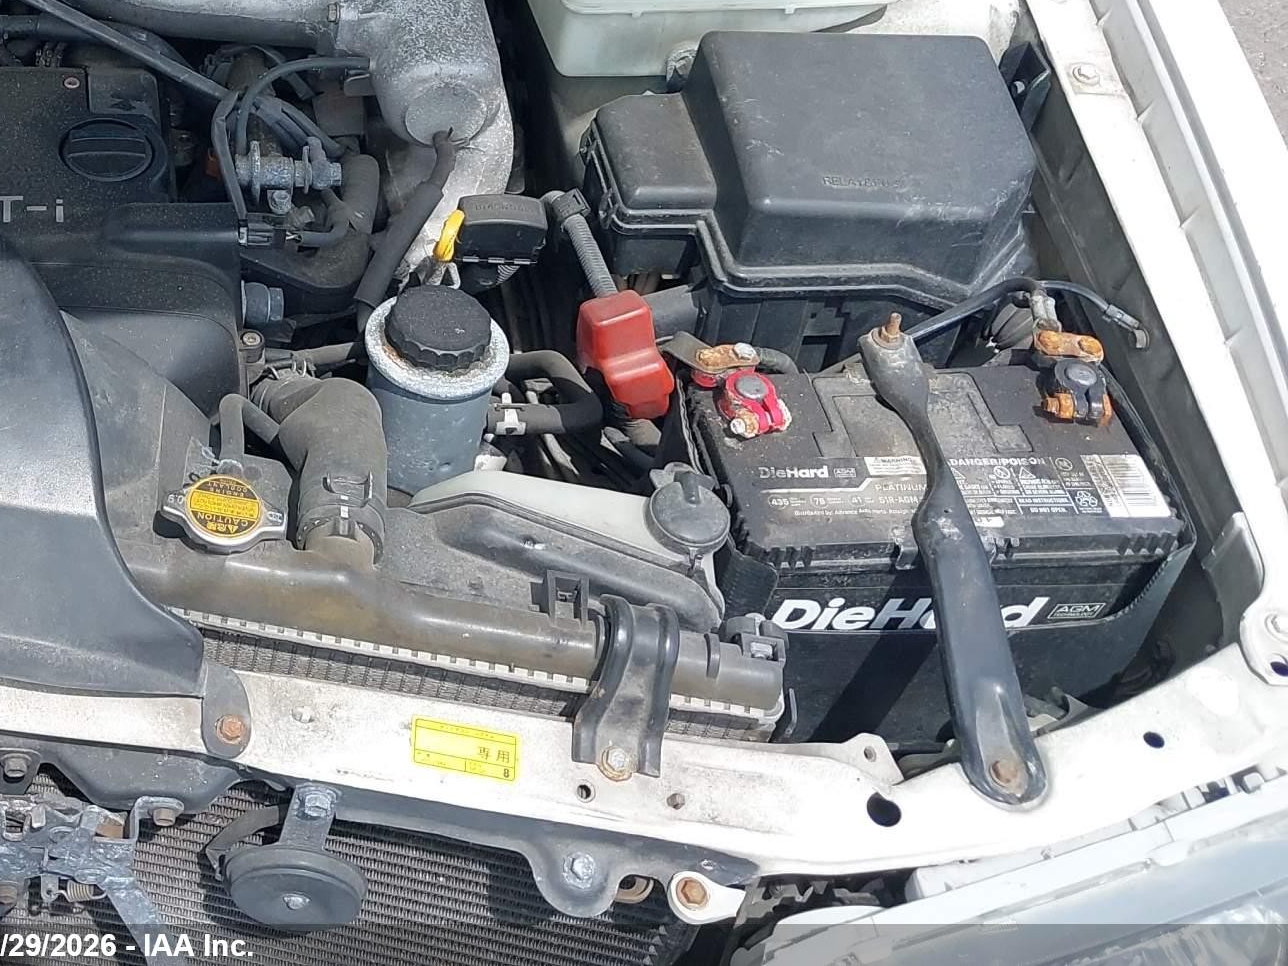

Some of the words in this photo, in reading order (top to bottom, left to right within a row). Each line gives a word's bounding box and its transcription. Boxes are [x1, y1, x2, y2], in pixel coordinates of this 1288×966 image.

[758, 465, 829, 478] DieHard
[167, 494, 184, 505] 0.9
[197, 512, 249, 527] CAUTION
[771, 596, 1050, 630] DieHd
[1057, 604, 1100, 613] AGM
